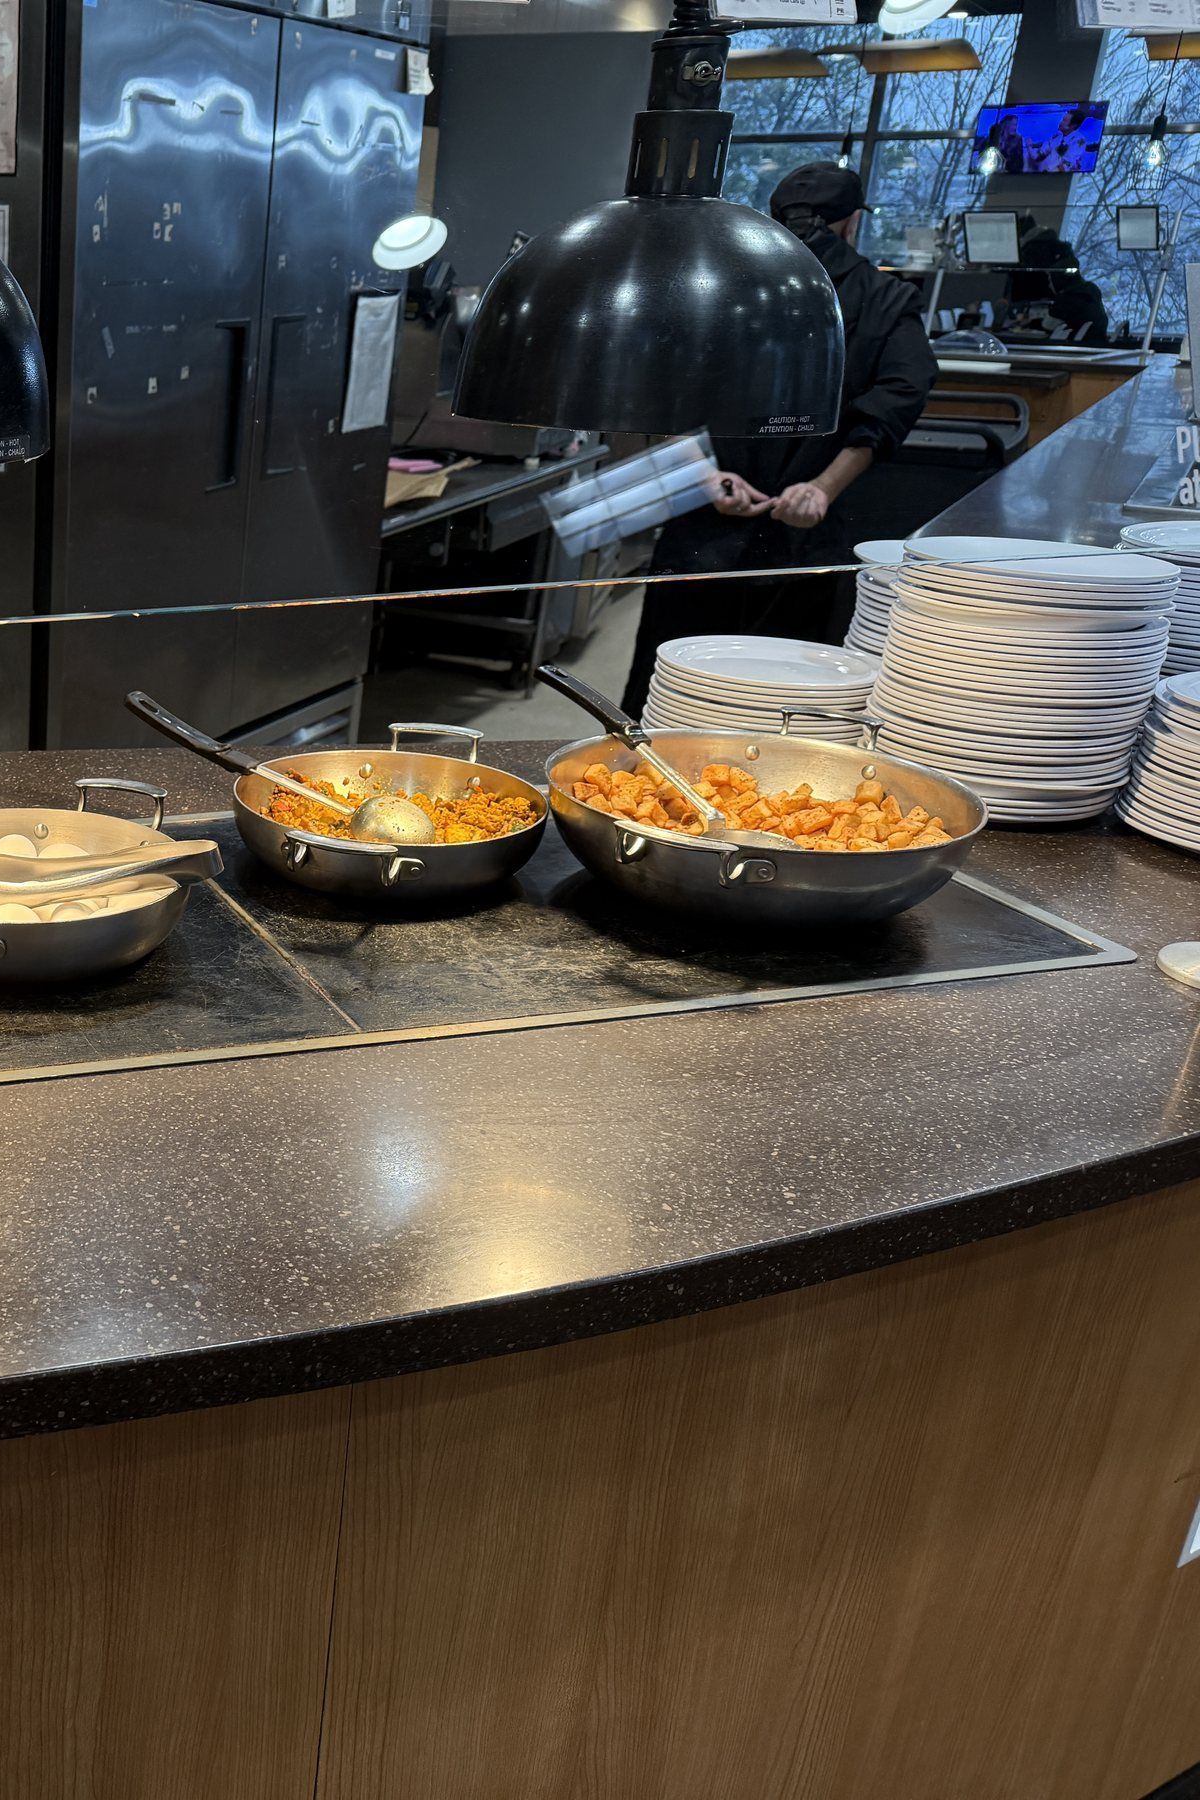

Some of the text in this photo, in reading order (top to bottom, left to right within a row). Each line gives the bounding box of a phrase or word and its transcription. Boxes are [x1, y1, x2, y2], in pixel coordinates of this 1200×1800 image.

[769, 416, 796, 424] CAUTION
[799, 415, 811, 423] HOT
[758, 425, 794, 433] ATTENTION
[9, 438, 20, 447] HOT
